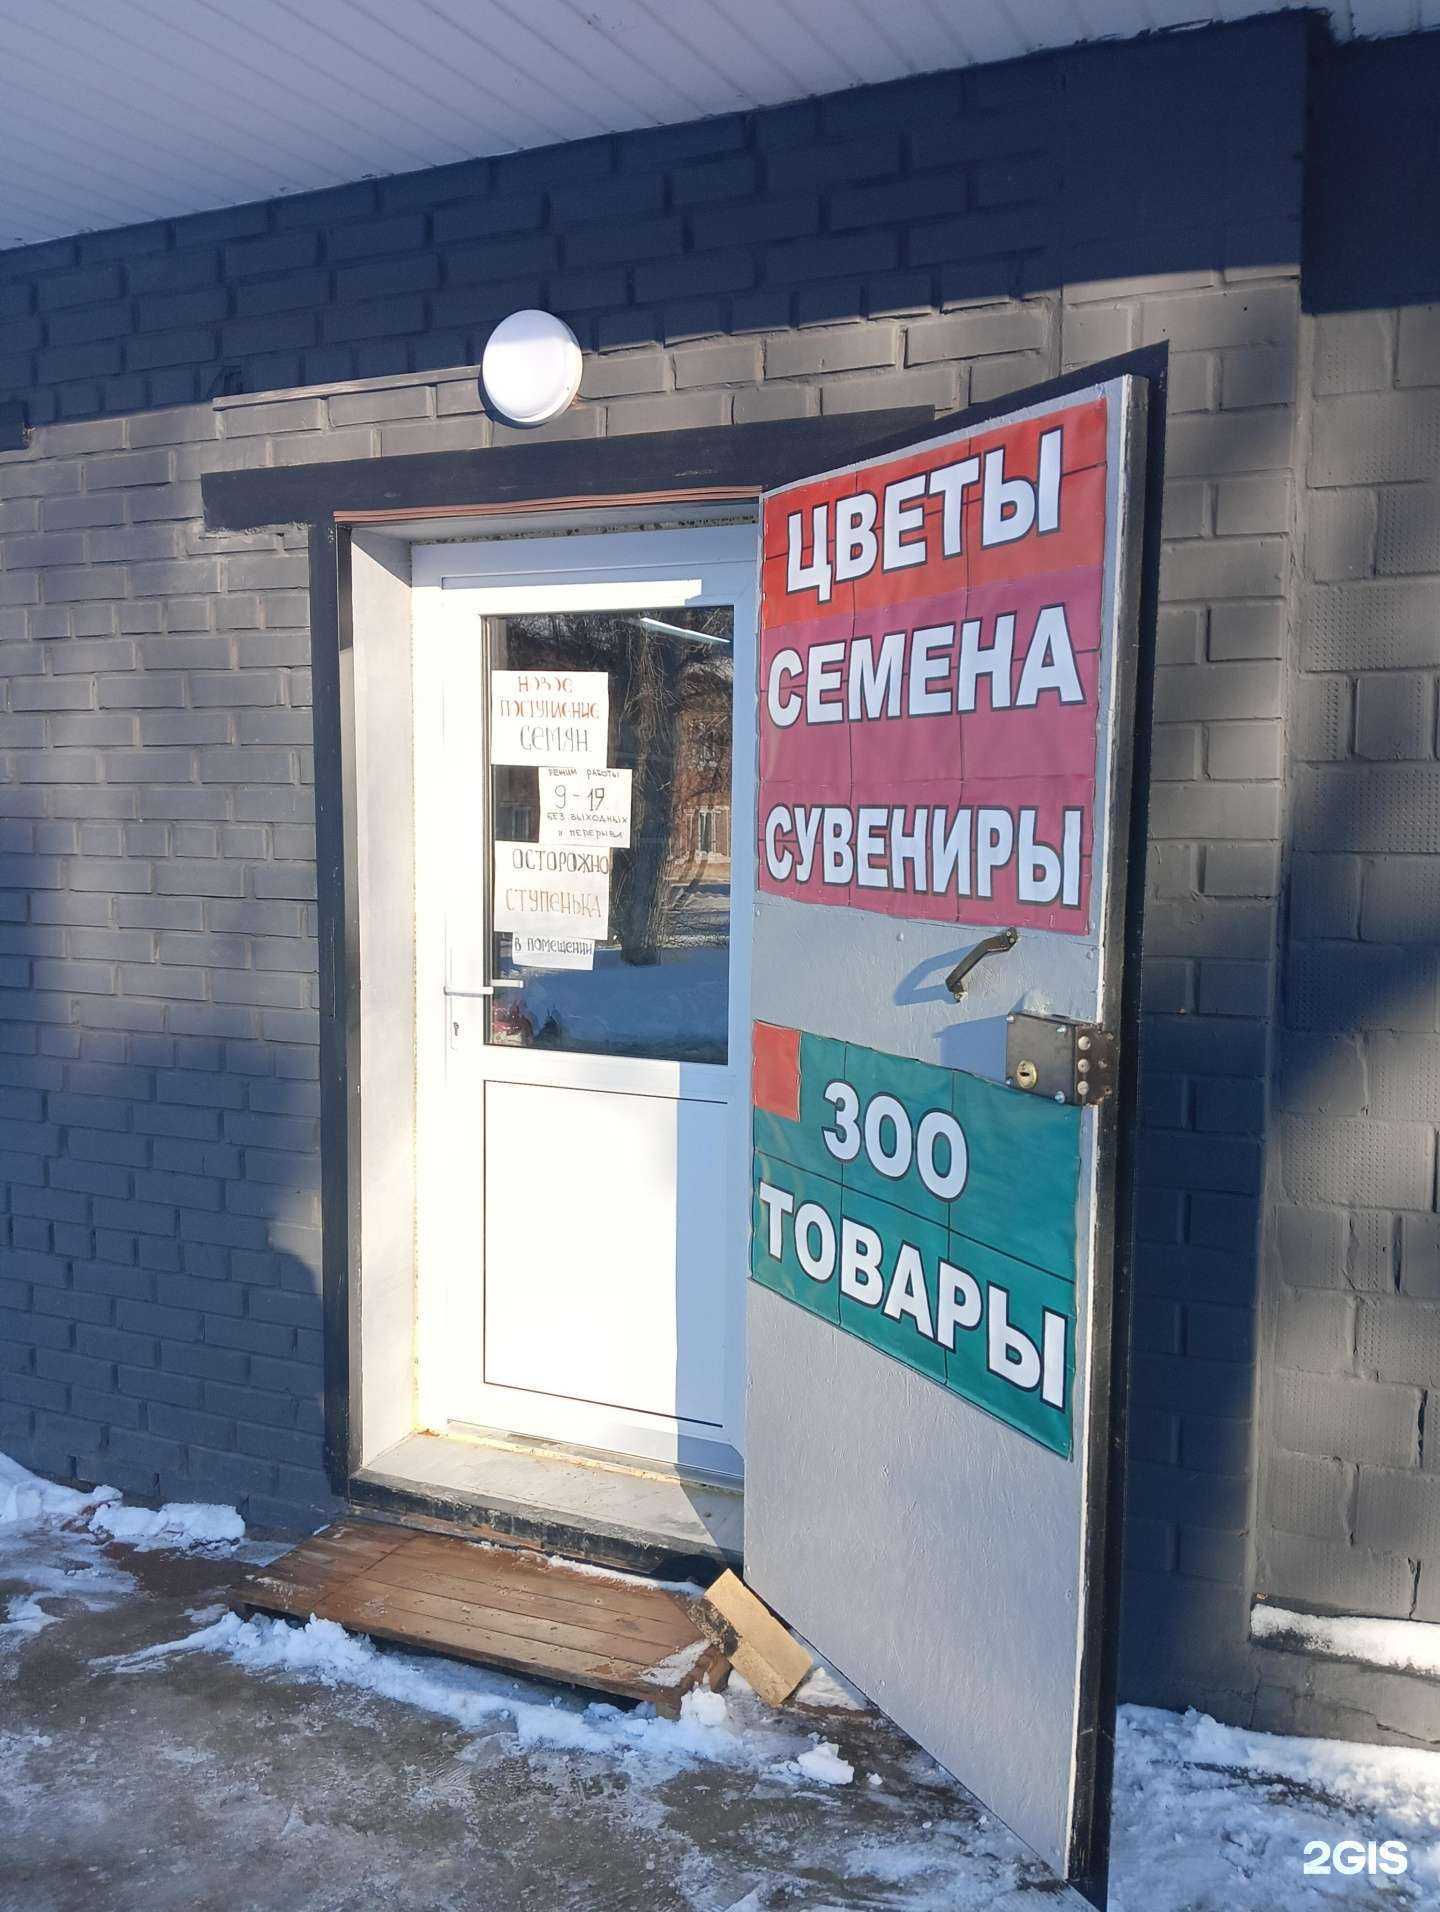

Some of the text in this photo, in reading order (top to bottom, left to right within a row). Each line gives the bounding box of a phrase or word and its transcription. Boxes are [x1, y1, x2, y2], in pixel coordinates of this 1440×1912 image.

[786, 425, 1064, 603] ЦВЕТЫ
[767, 603, 1087, 729] СЕМЕНА
[520, 725, 589, 752] СЕМЯН
[506, 888, 602, 918] СТУПЕНЬКА
[512, 848, 609, 875] ОСТОРОЖНО
[764, 803, 1084, 909] СУВЕНИРЫ
[514, 937, 593, 956] В ПОМЕЩЕНИИ
[821, 1079, 969, 1201] ЗОО
[758, 1178, 1068, 1413] ТОВАРЫ
